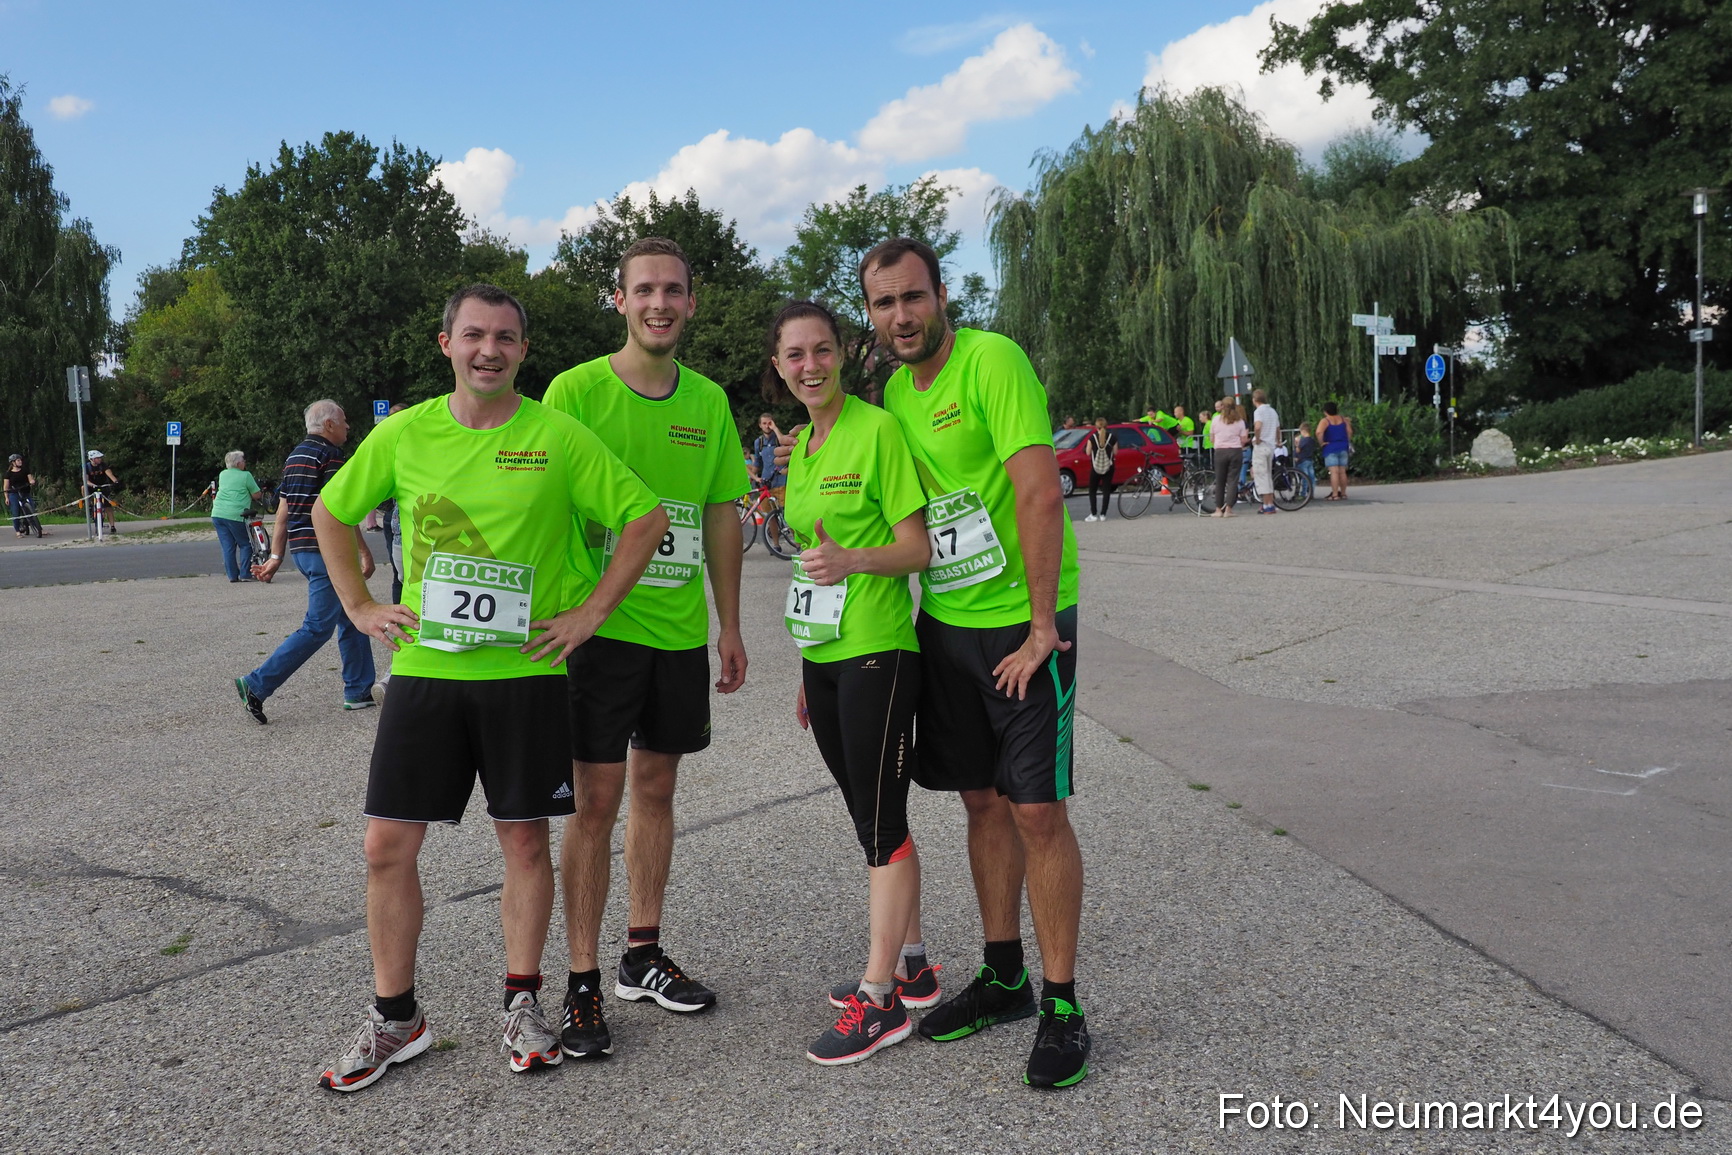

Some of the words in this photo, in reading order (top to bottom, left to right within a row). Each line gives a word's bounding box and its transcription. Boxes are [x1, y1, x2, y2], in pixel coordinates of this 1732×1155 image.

[377, 402, 386, 414] P
[170, 423, 178, 435] P
[495, 456, 549, 465] ELEMENTELAUF
[431, 557, 525, 591] BOCK
[929, 552, 995, 582] SEBASTIAN
[450, 590, 497, 623] 20
[793, 587, 813, 616] 21
[443, 628, 497, 644] PETER
[791, 623, 811, 638] NINA
